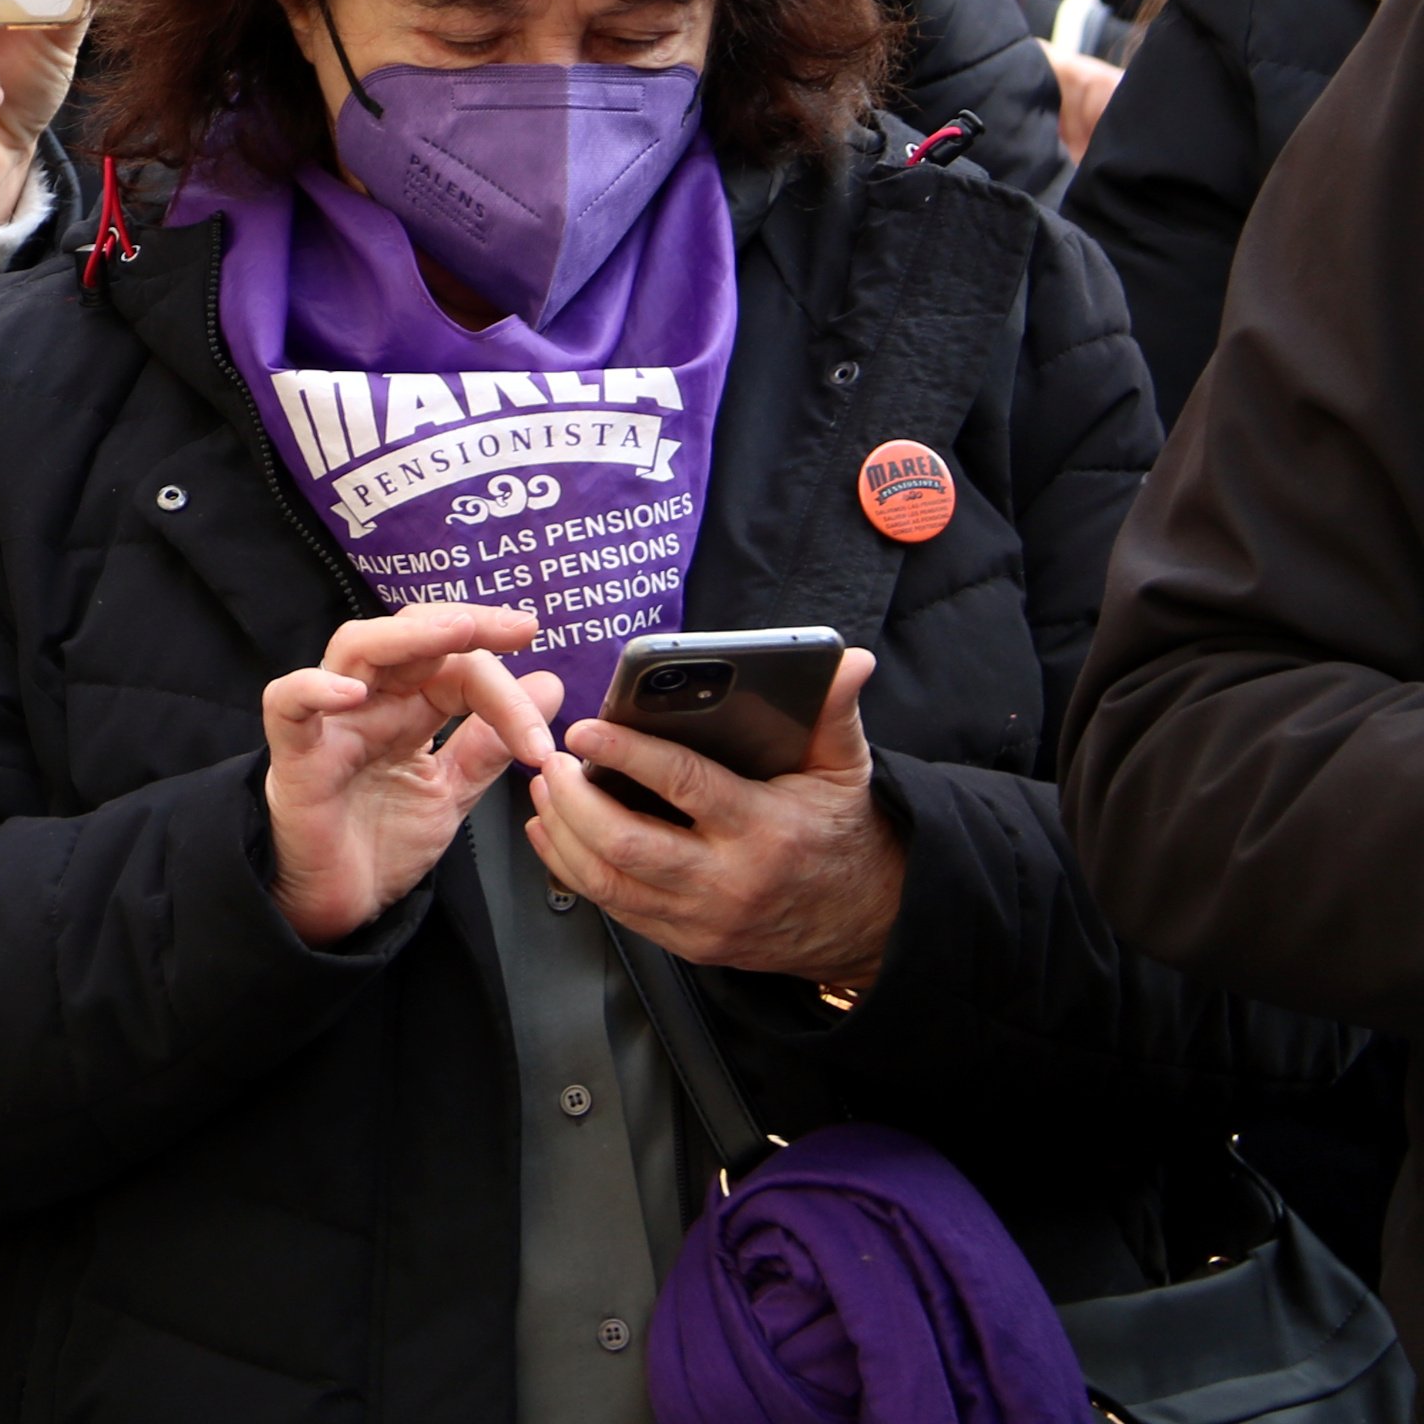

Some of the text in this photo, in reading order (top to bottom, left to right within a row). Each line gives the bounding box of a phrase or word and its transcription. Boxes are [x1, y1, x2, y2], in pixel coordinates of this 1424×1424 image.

[410, 154, 485, 218] PALENS
[353, 421, 643, 508] PENSIONISTA
[866, 454, 945, 493] MAREA
[478, 528, 537, 562] LAS
[544, 492, 694, 547] PENSIONES
[376, 532, 680, 605] SALVEM LES PENSIONS
[544, 566, 680, 615] PENSIÓNS
[514, 604, 663, 656] ENTSIOAK
